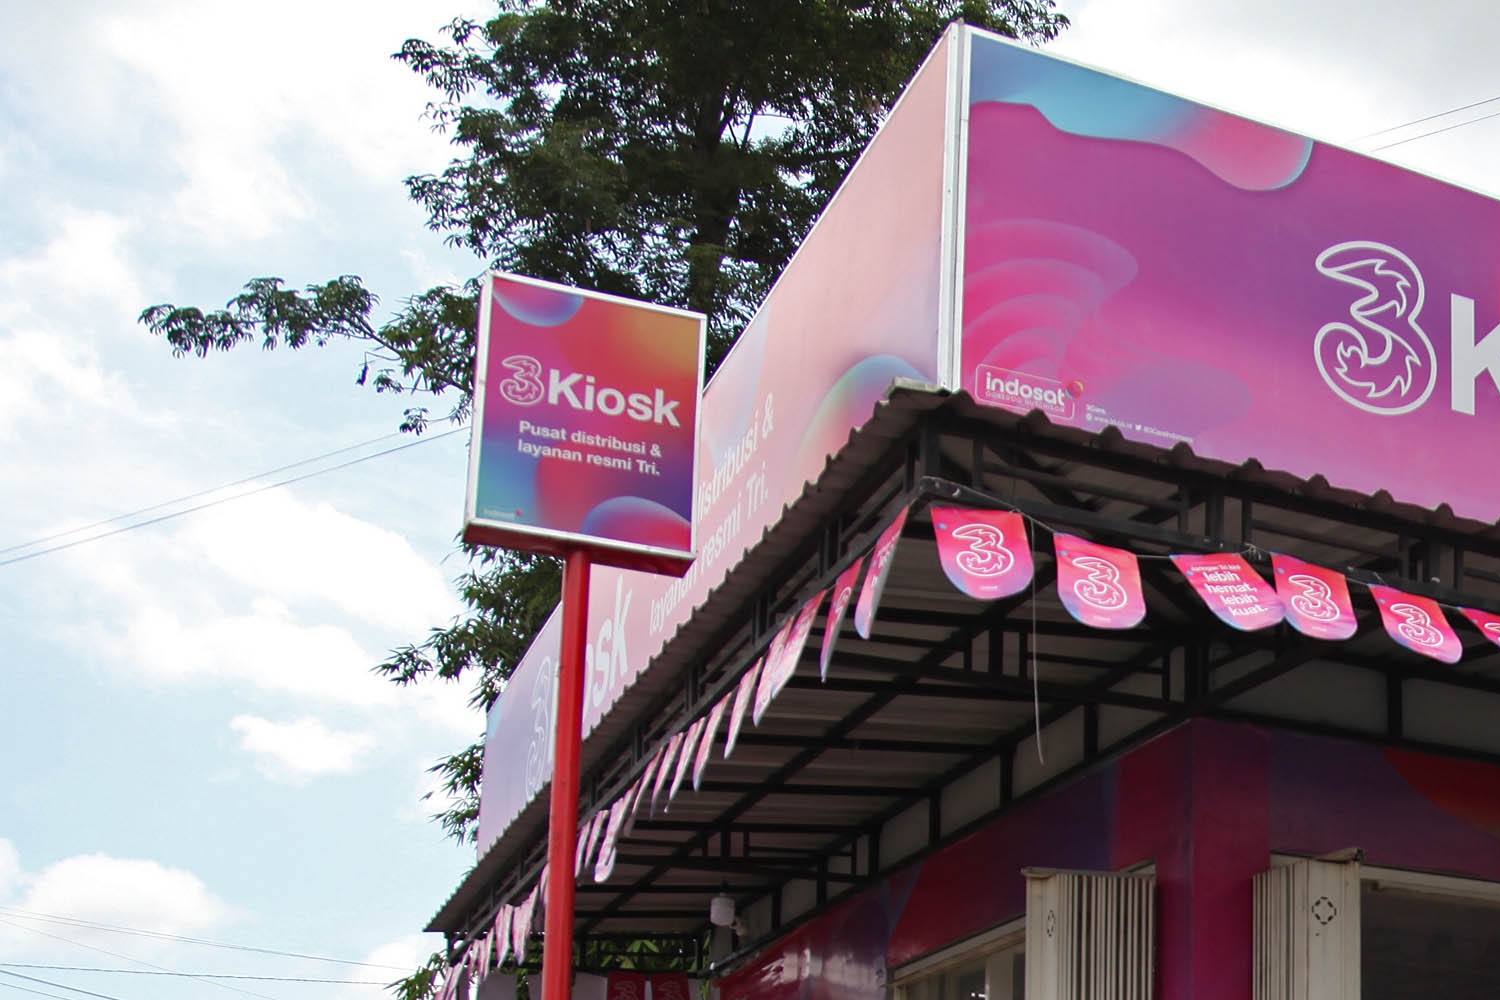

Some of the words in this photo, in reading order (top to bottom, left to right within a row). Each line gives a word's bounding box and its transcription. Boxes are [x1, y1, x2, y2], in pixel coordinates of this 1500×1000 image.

[1313, 240, 1437, 416] 3
[500, 355, 545, 406] 3
[548, 368, 681, 428] Kiosk
[985, 372, 1065, 406] indosat
[519, 420, 567, 441] Pusat
[570, 429, 646, 455] distribusi
[650, 443, 662, 458] &
[518, 439, 582, 463] layanan
[586, 453, 632, 471] resmi
[636, 459, 660, 476] Tri.
[651, 563, 698, 635] layanan
[701, 492, 742, 569] resmi
[1204, 570, 1240, 584] lebih
[1204, 581, 1258, 595] hemat,
[1220, 593, 1258, 606] lebih
[1229, 604, 1269, 617] kuat.
